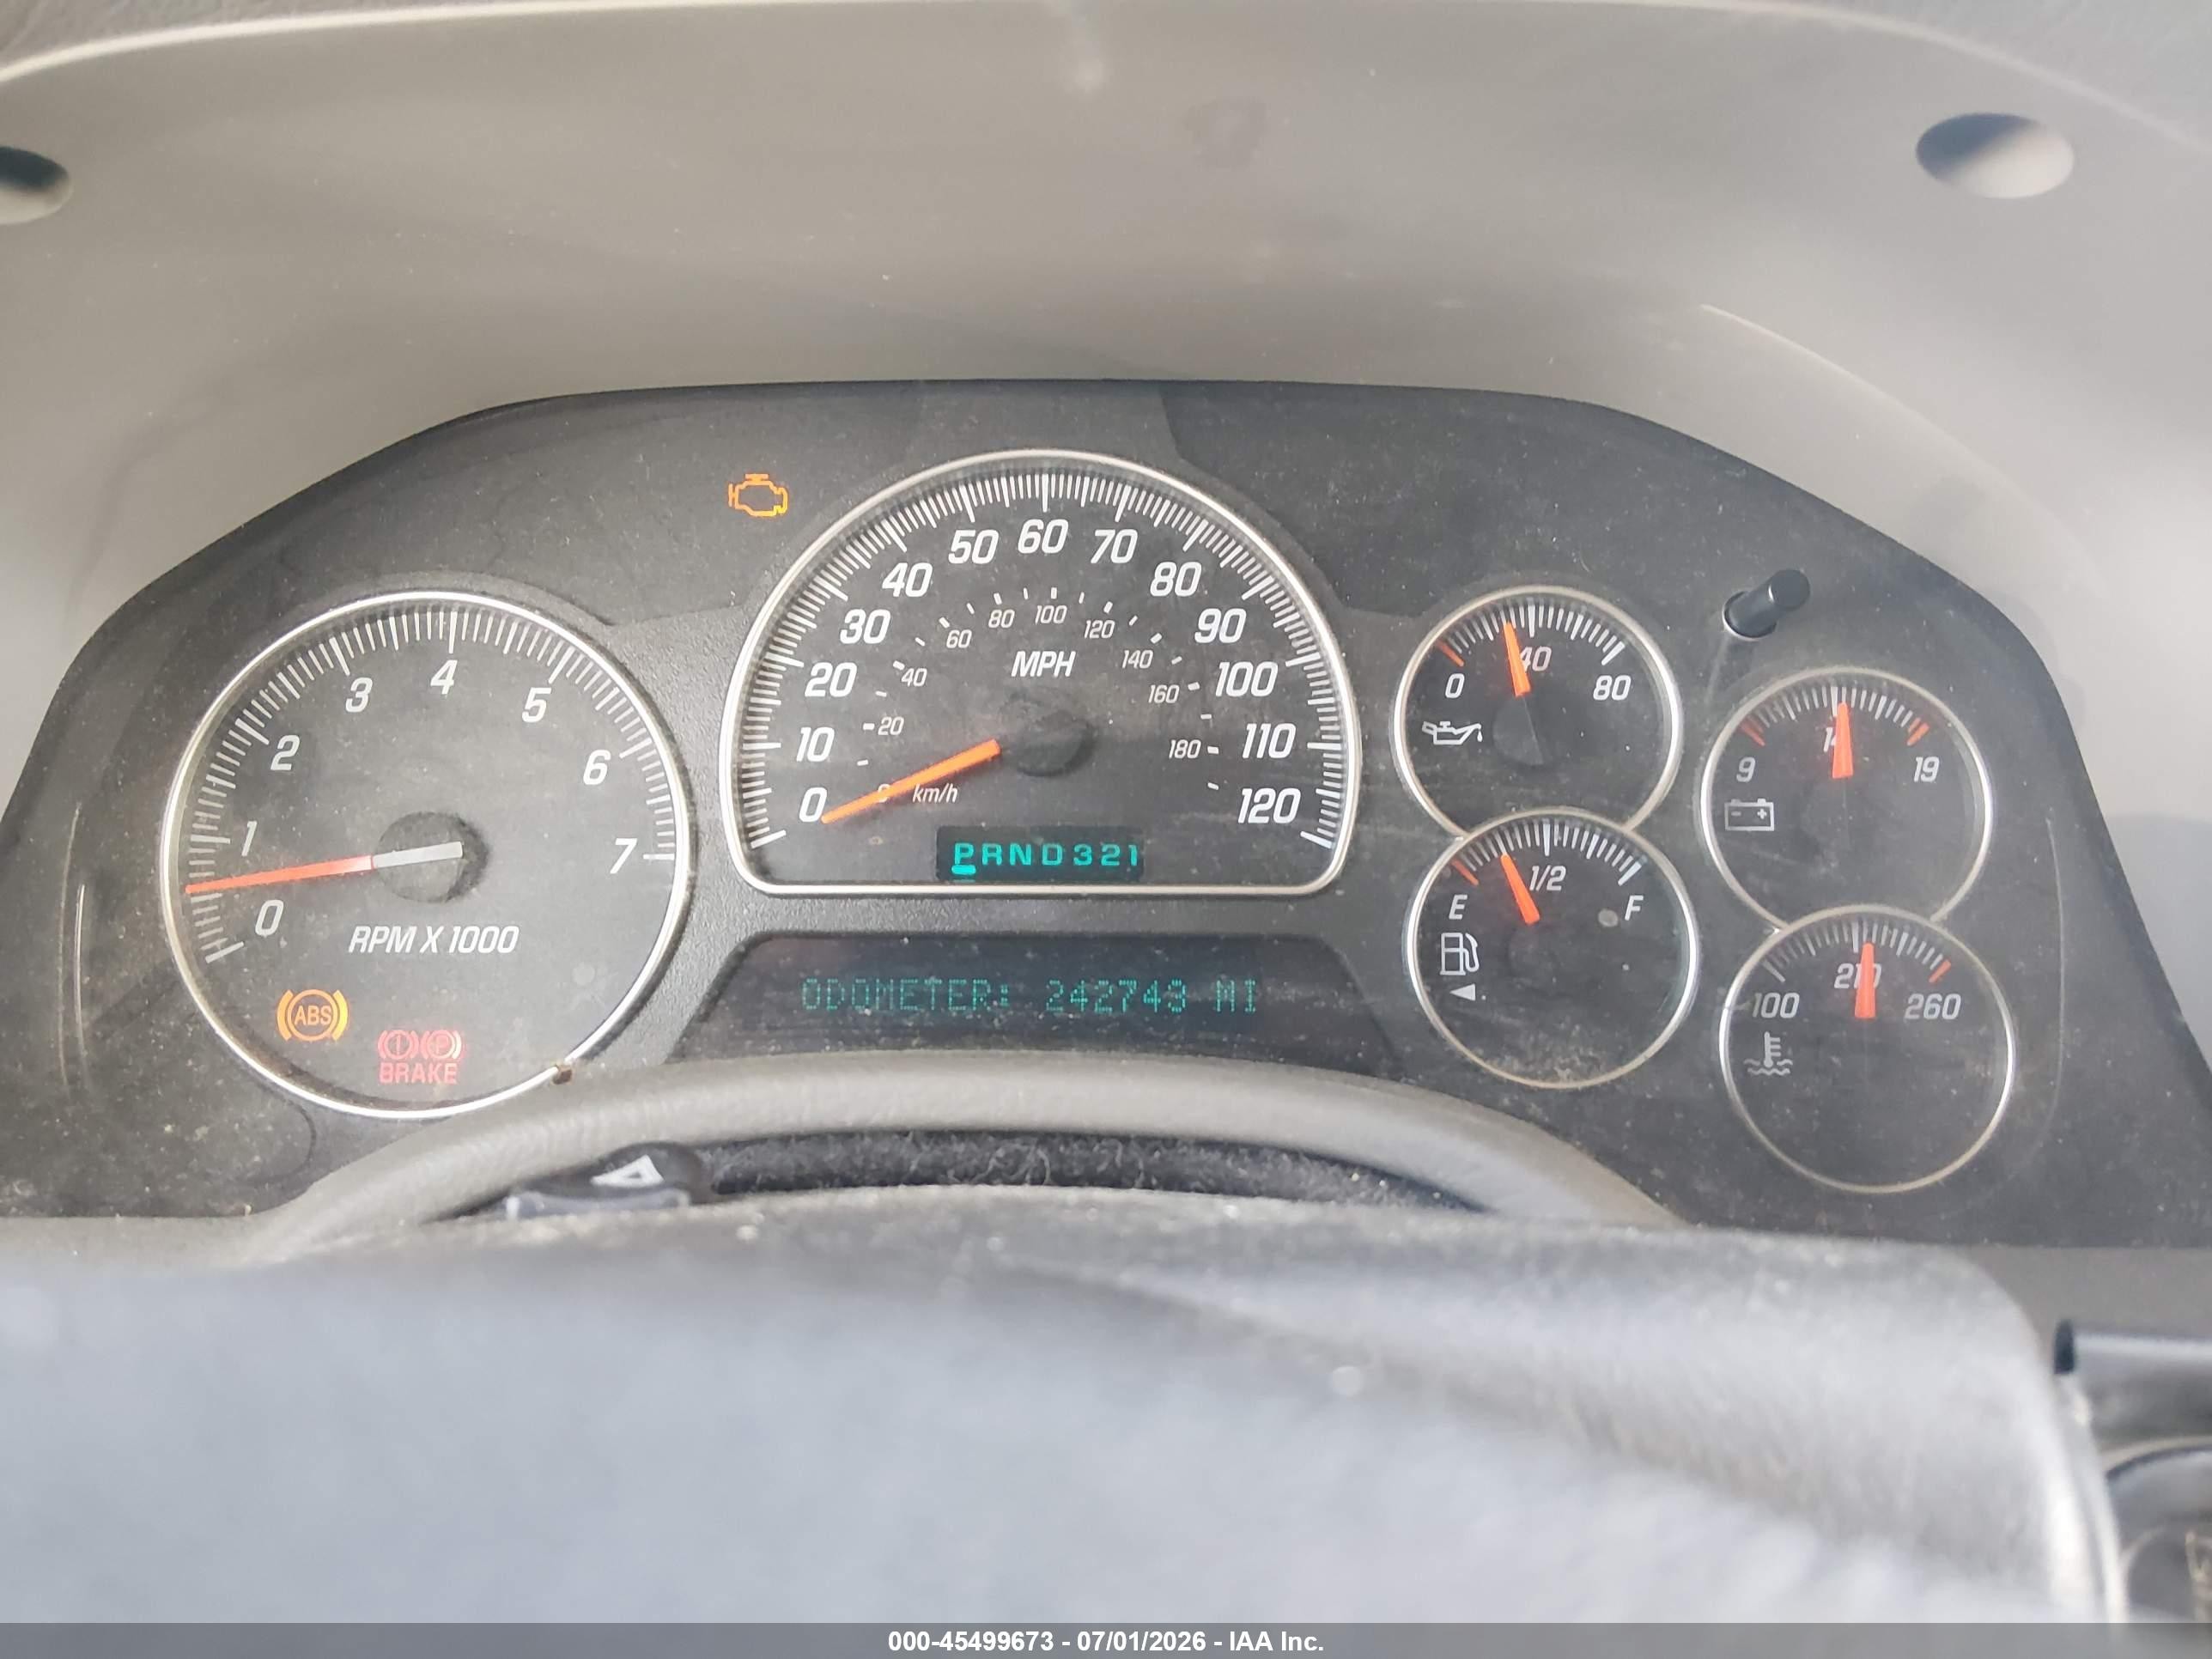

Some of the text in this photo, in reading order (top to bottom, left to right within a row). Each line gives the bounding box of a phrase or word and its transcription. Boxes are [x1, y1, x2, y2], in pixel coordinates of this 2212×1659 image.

[948, 529, 999, 563] 50
[1017, 519, 1069, 553] 60
[1091, 529, 1138, 563] 70
[882, 562, 933, 597] 40
[1150, 562, 1201, 597] 80
[839, 609, 890, 644] 30
[988, 609, 1014, 629] 80
[1034, 605, 1067, 624] 100
[1194, 608, 1246, 643] 90
[946, 629, 972, 649] 60
[1085, 619, 1115, 639] 120
[1012, 651, 1075, 678] MPH
[1122, 649, 1154, 669] 140
[1520, 646, 1553, 672] 40
[430, 659, 457, 695] 4
[805, 662, 857, 697] 20
[902, 666, 927, 686] 40
[1214, 661, 1278, 696] 100
[1444, 674, 1466, 698] 0
[1592, 677, 1632, 701] 80
[345, 677, 373, 713] 3
[522, 688, 551, 722] 5
[1148, 684, 1179, 704] 160
[878, 716, 904, 736] 20
[270, 736, 300, 771] 2
[796, 726, 834, 761] 10
[1169, 738, 1200, 759] 180
[1242, 723, 1296, 759] 110
[583, 750, 611, 785] 6
[1736, 757, 1755, 782] 9
[1913, 757, 1940, 782] 19
[799, 787, 828, 823] 0
[913, 782, 958, 803] km/h
[1237, 788, 1301, 824] 120
[241, 821, 258, 856] 1
[610, 838, 637, 874] 7
[1529, 865, 1567, 891] 1/2
[255, 901, 284, 936] 0
[1449, 894, 1468, 920] E
[1624, 895, 1644, 921] F
[348, 926, 520, 954] RPM X 1000
[801, 979, 1257, 1014] ODOMETER: 242743 MI
[1751, 993, 1799, 1018] 100
[1905, 994, 1961, 1019] 260
[295, 1005, 331, 1026] ABS
[380, 1062, 459, 1085] BRAKE
